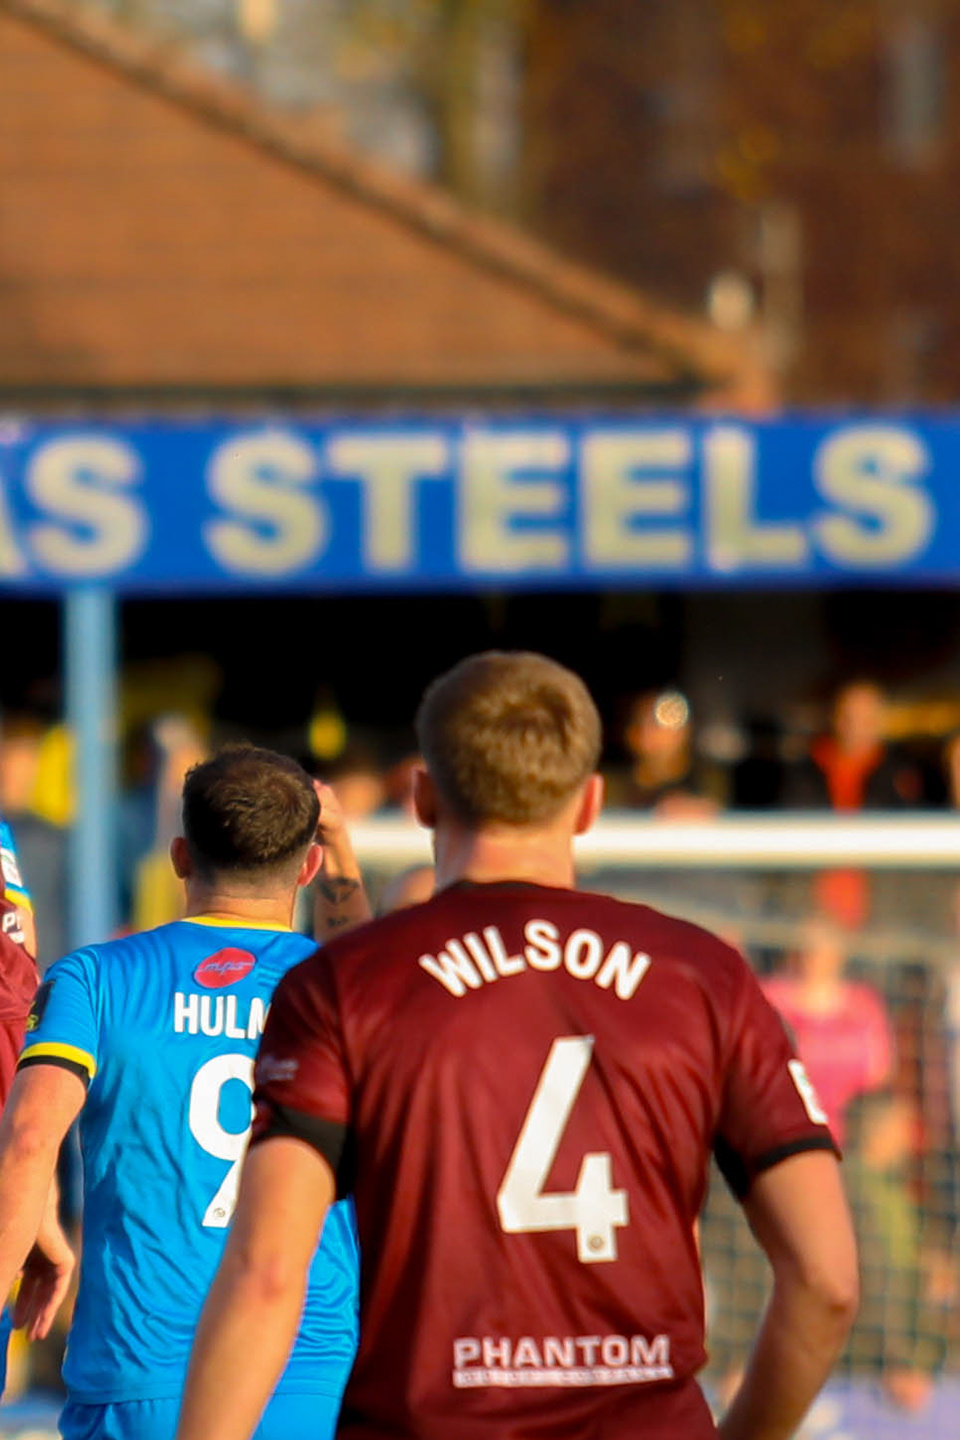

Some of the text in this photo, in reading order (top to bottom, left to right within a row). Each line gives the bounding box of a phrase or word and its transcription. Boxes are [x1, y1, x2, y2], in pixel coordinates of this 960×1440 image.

[203, 425, 935, 578] STEELS
[420, 920, 650, 999] WILSON
[188, 1053, 256, 1228] 9
[496, 1035, 628, 1263] 4
[453, 1334, 670, 1368] PHANTOM
